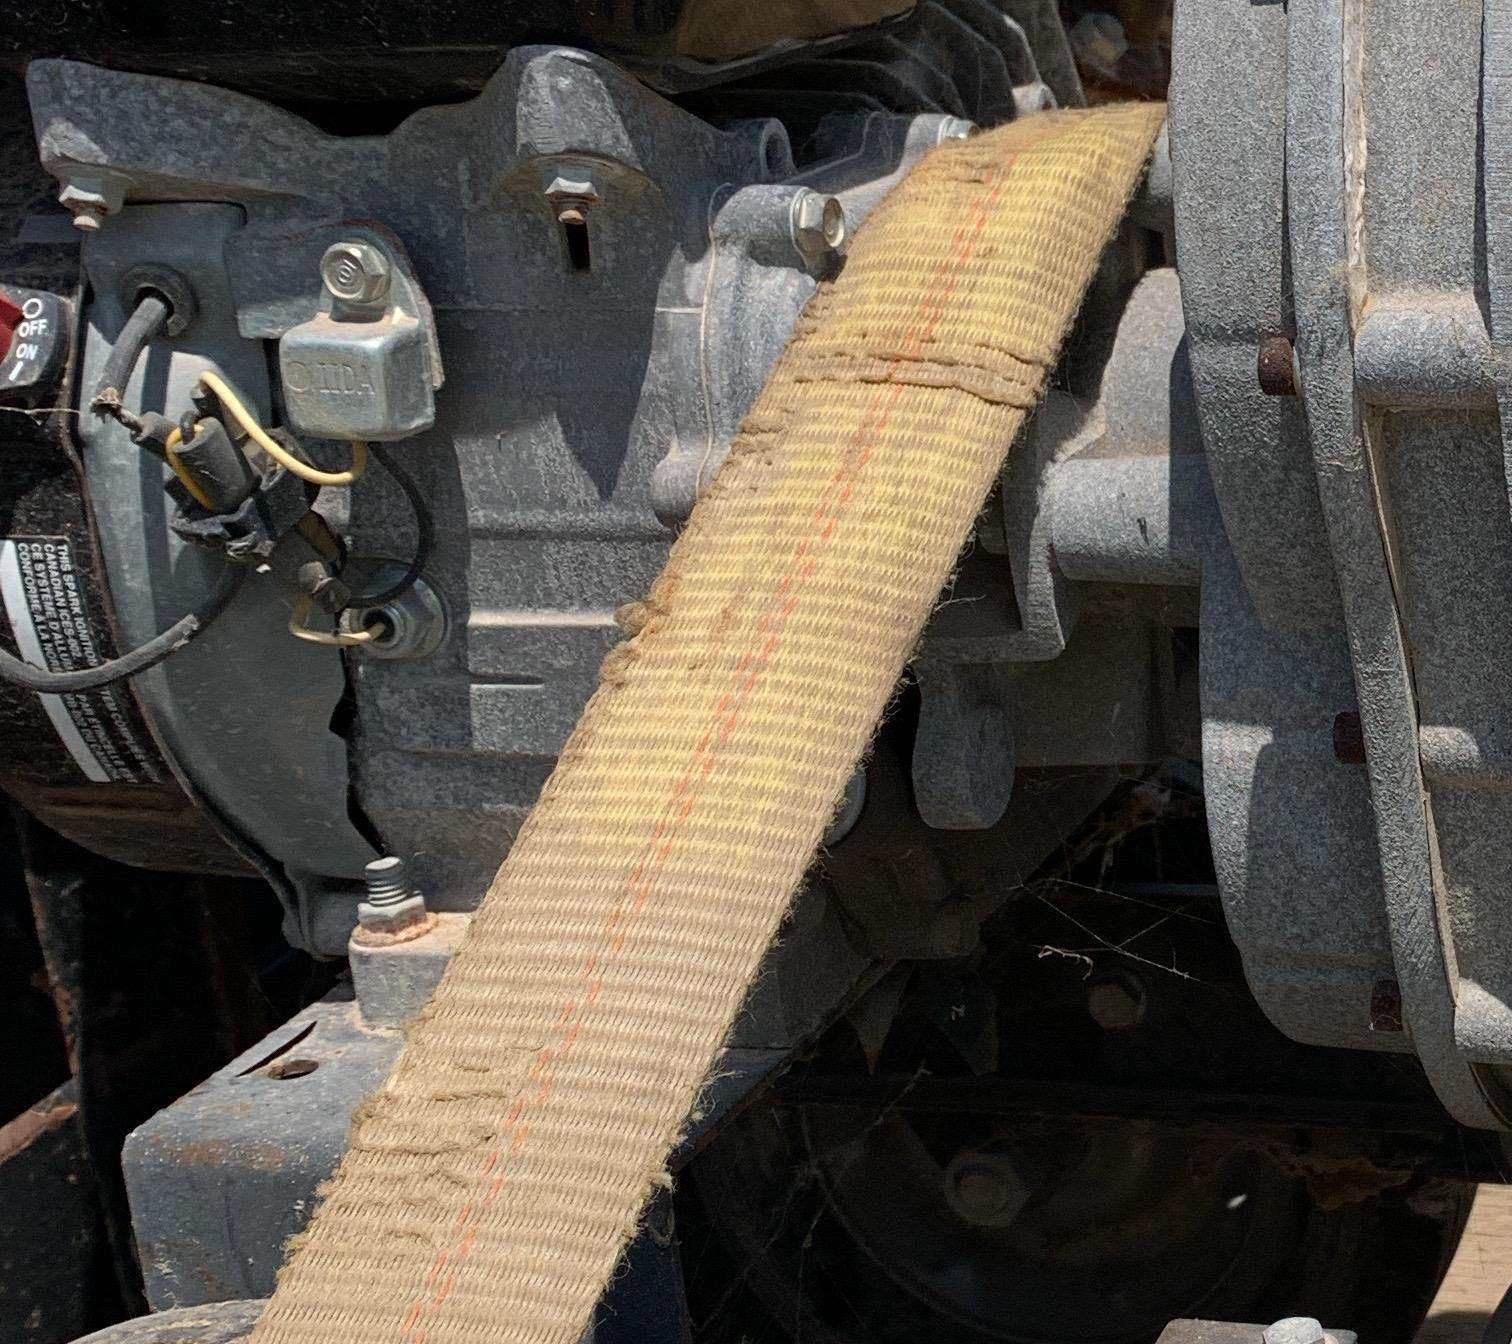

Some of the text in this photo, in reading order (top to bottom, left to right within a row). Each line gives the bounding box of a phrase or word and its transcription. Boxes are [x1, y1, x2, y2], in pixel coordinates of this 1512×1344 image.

[19, 319, 48, 337] OFF
[16, 343, 38, 360] ON
[31, 542, 44, 561] CE
[57, 544, 72, 572] THIS
[18, 542, 42, 614] CONFORME
[37, 625, 49, 640] LA
[44, 543, 66, 607] CANADIAN
[62, 574, 82, 615] SPARK
[74, 617, 98, 667] IGNITION
